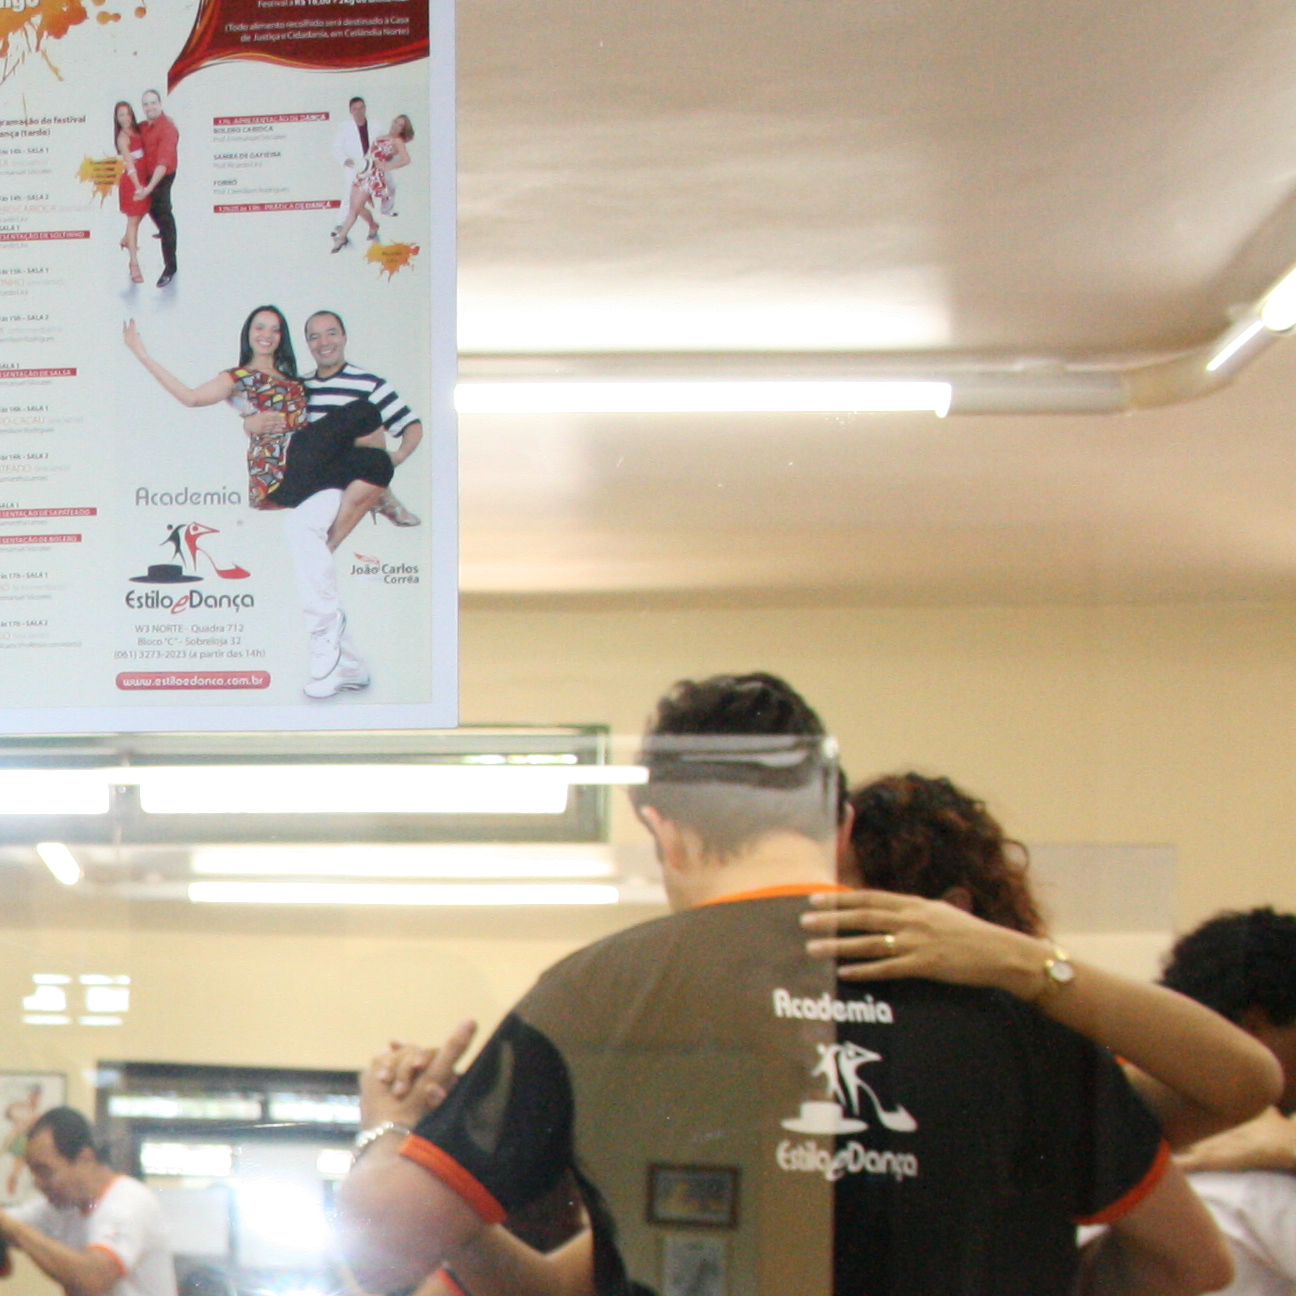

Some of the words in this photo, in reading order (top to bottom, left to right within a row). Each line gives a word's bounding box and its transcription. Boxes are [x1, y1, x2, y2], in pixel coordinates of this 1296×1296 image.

[135, 487, 242, 506] Academia
[351, 564, 380, 576] João
[382, 563, 419, 575] Carlos
[772, 987, 894, 1024] Academia
